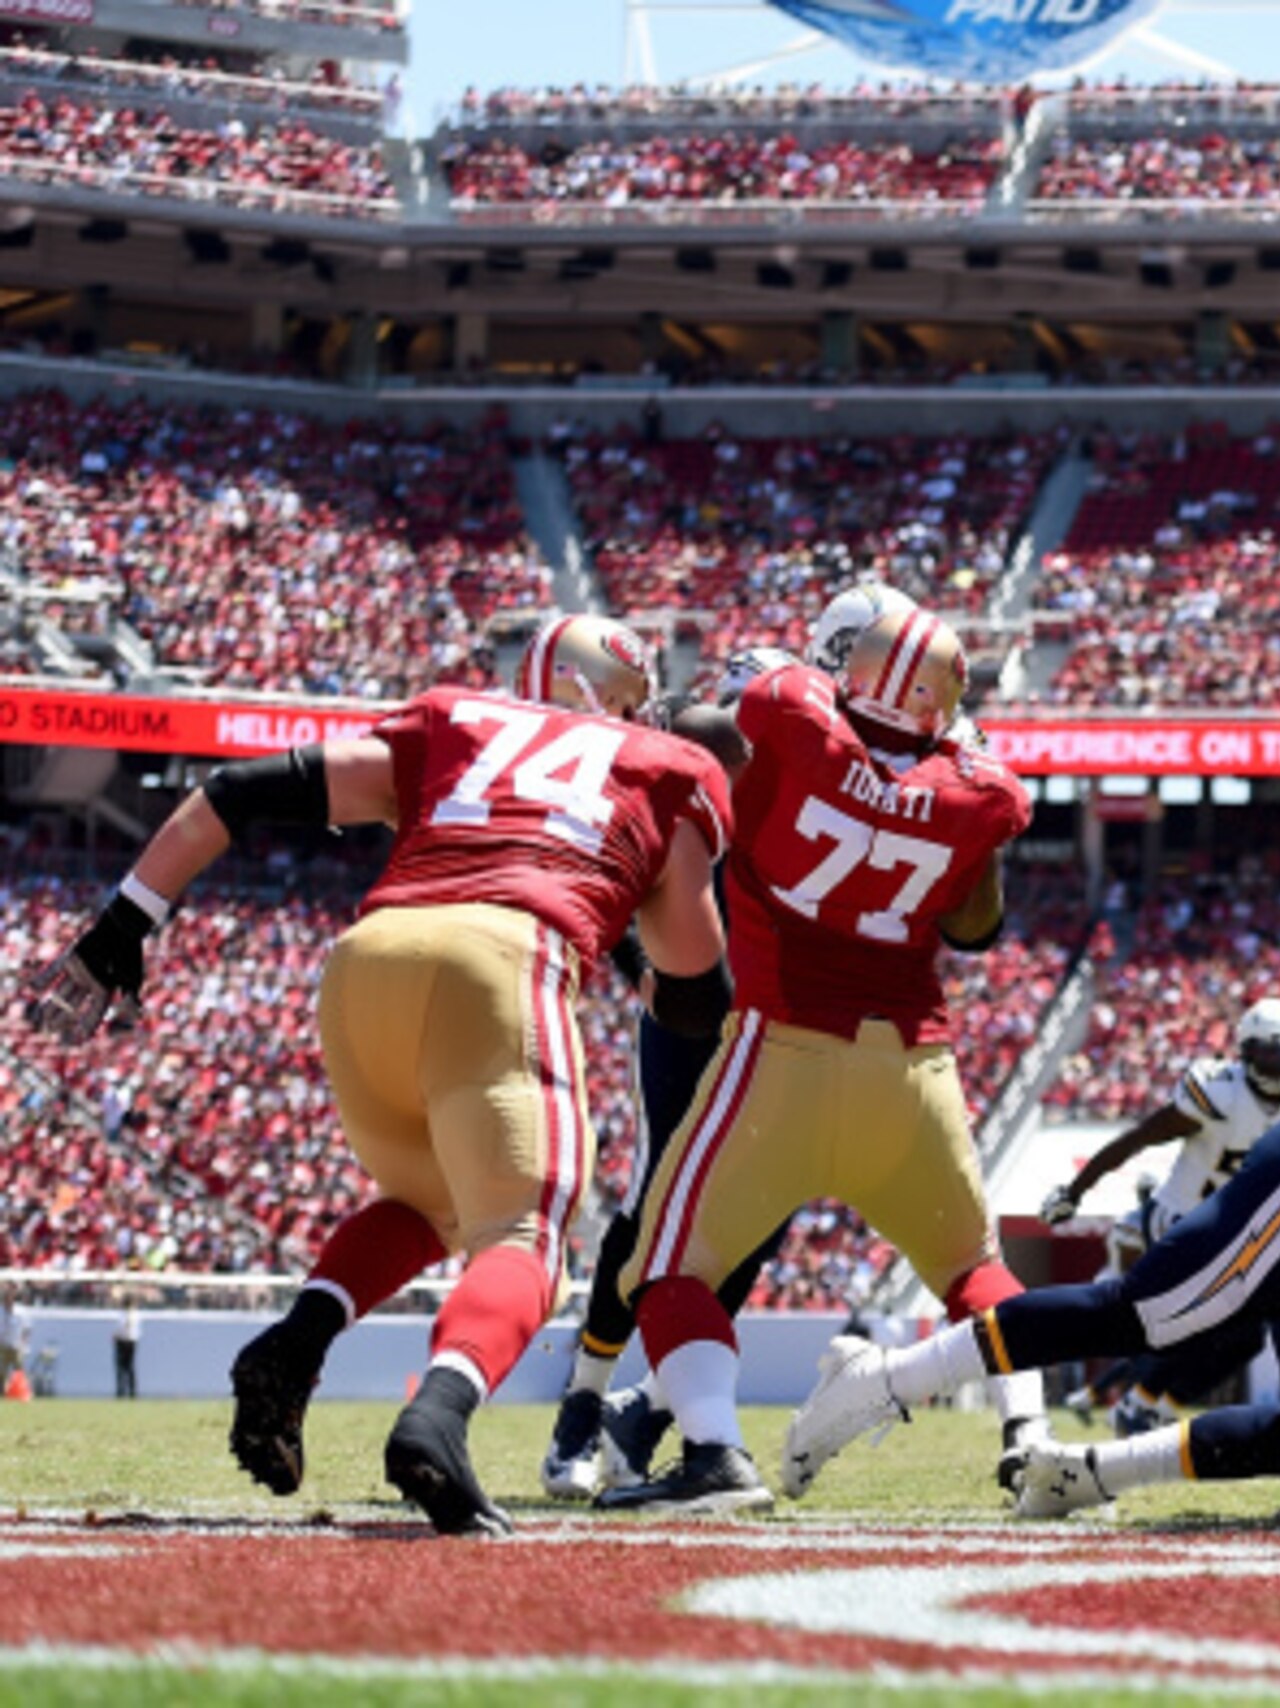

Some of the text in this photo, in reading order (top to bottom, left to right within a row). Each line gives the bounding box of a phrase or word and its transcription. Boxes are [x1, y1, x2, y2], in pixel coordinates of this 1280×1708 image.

[216, 712, 318, 748] HELLO
[985, 731, 1192, 764] EXPERIENCE
[1202, 731, 1252, 764] ON
[430, 699, 627, 857] 74
[769, 795, 954, 943] 77
